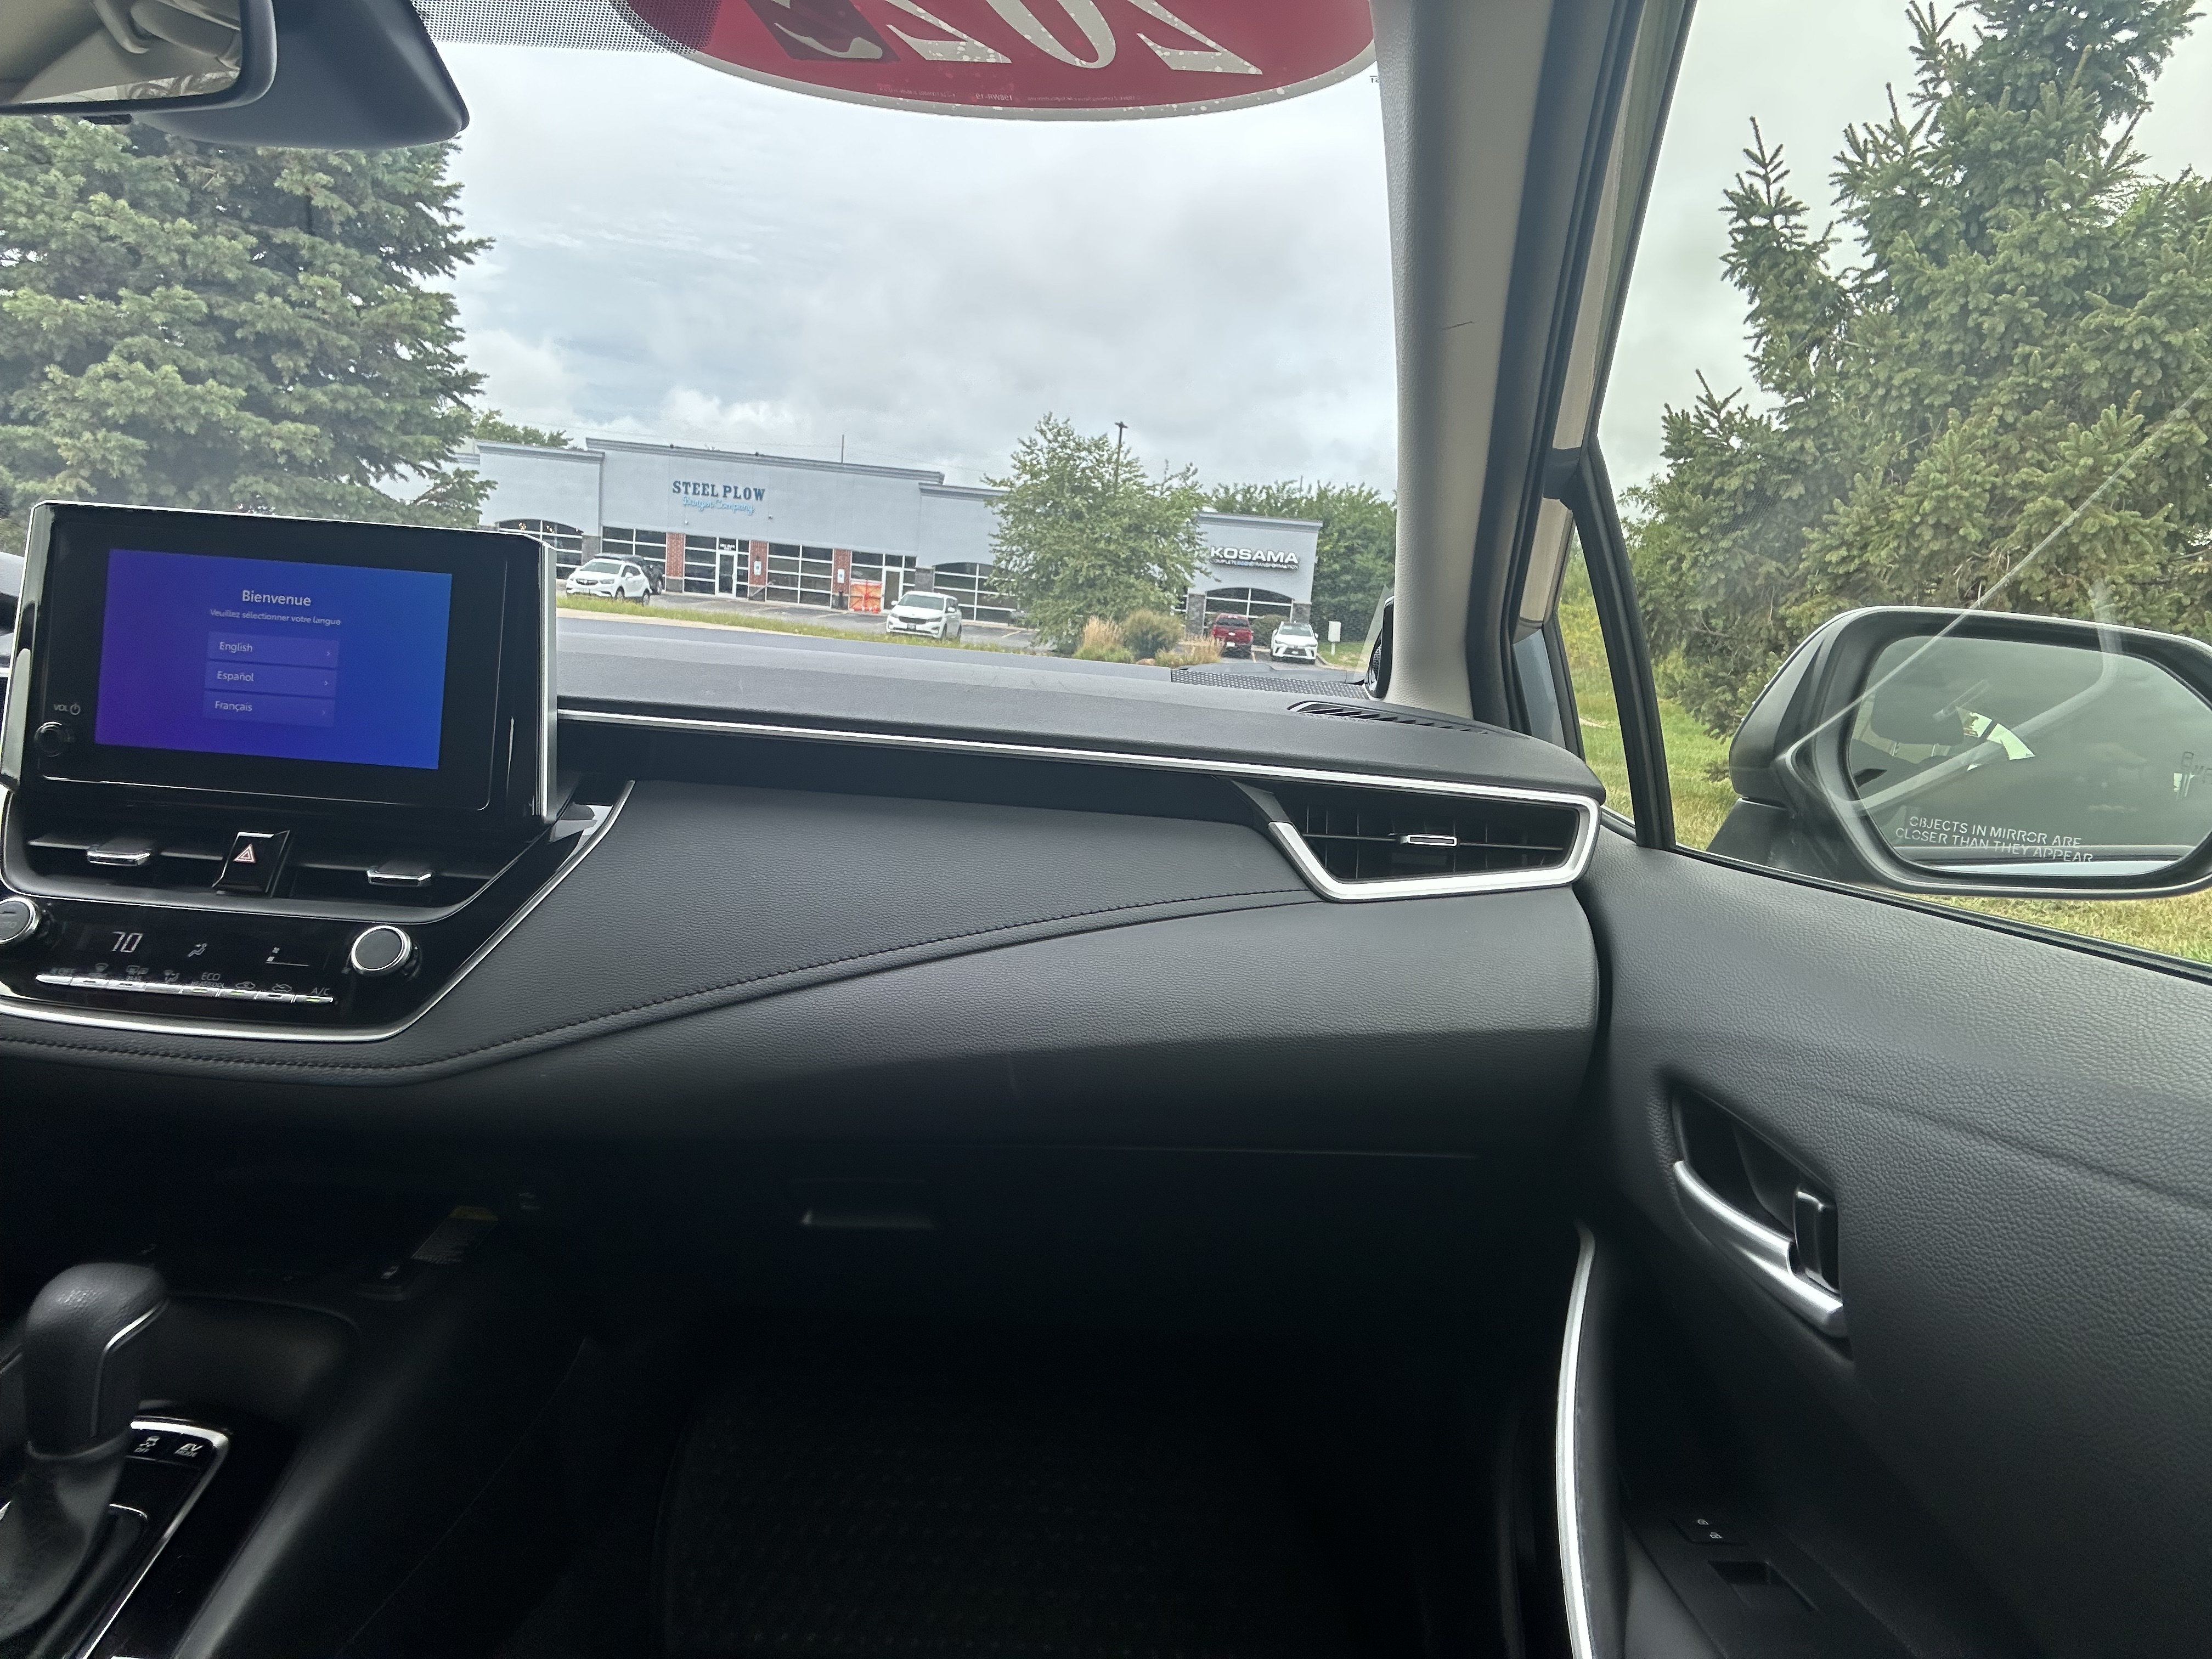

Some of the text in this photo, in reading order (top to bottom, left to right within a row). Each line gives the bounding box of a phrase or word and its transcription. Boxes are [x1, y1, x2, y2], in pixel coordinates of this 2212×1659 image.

[673, 481, 765, 501] STEEL PLOW
[1210, 547, 1299, 563] KOSAMA
[242, 590, 312, 606] Bienvenue
[210, 609, 240, 618] Veuillez
[242, 611, 290, 622] sélectionner
[313, 616, 341, 627] langue
[219, 641, 253, 653] English
[217, 671, 254, 682] Español
[215, 701, 252, 712] Français
[1909, 816, 2083, 848] OBJECTS IN MIRROR ARE
[1895, 828, 2093, 862] CLOSER THAN THEY APPEAR
[111, 931, 143, 953] 70
[201, 972, 221, 981] ECO
[311, 987, 330, 996] A/C
